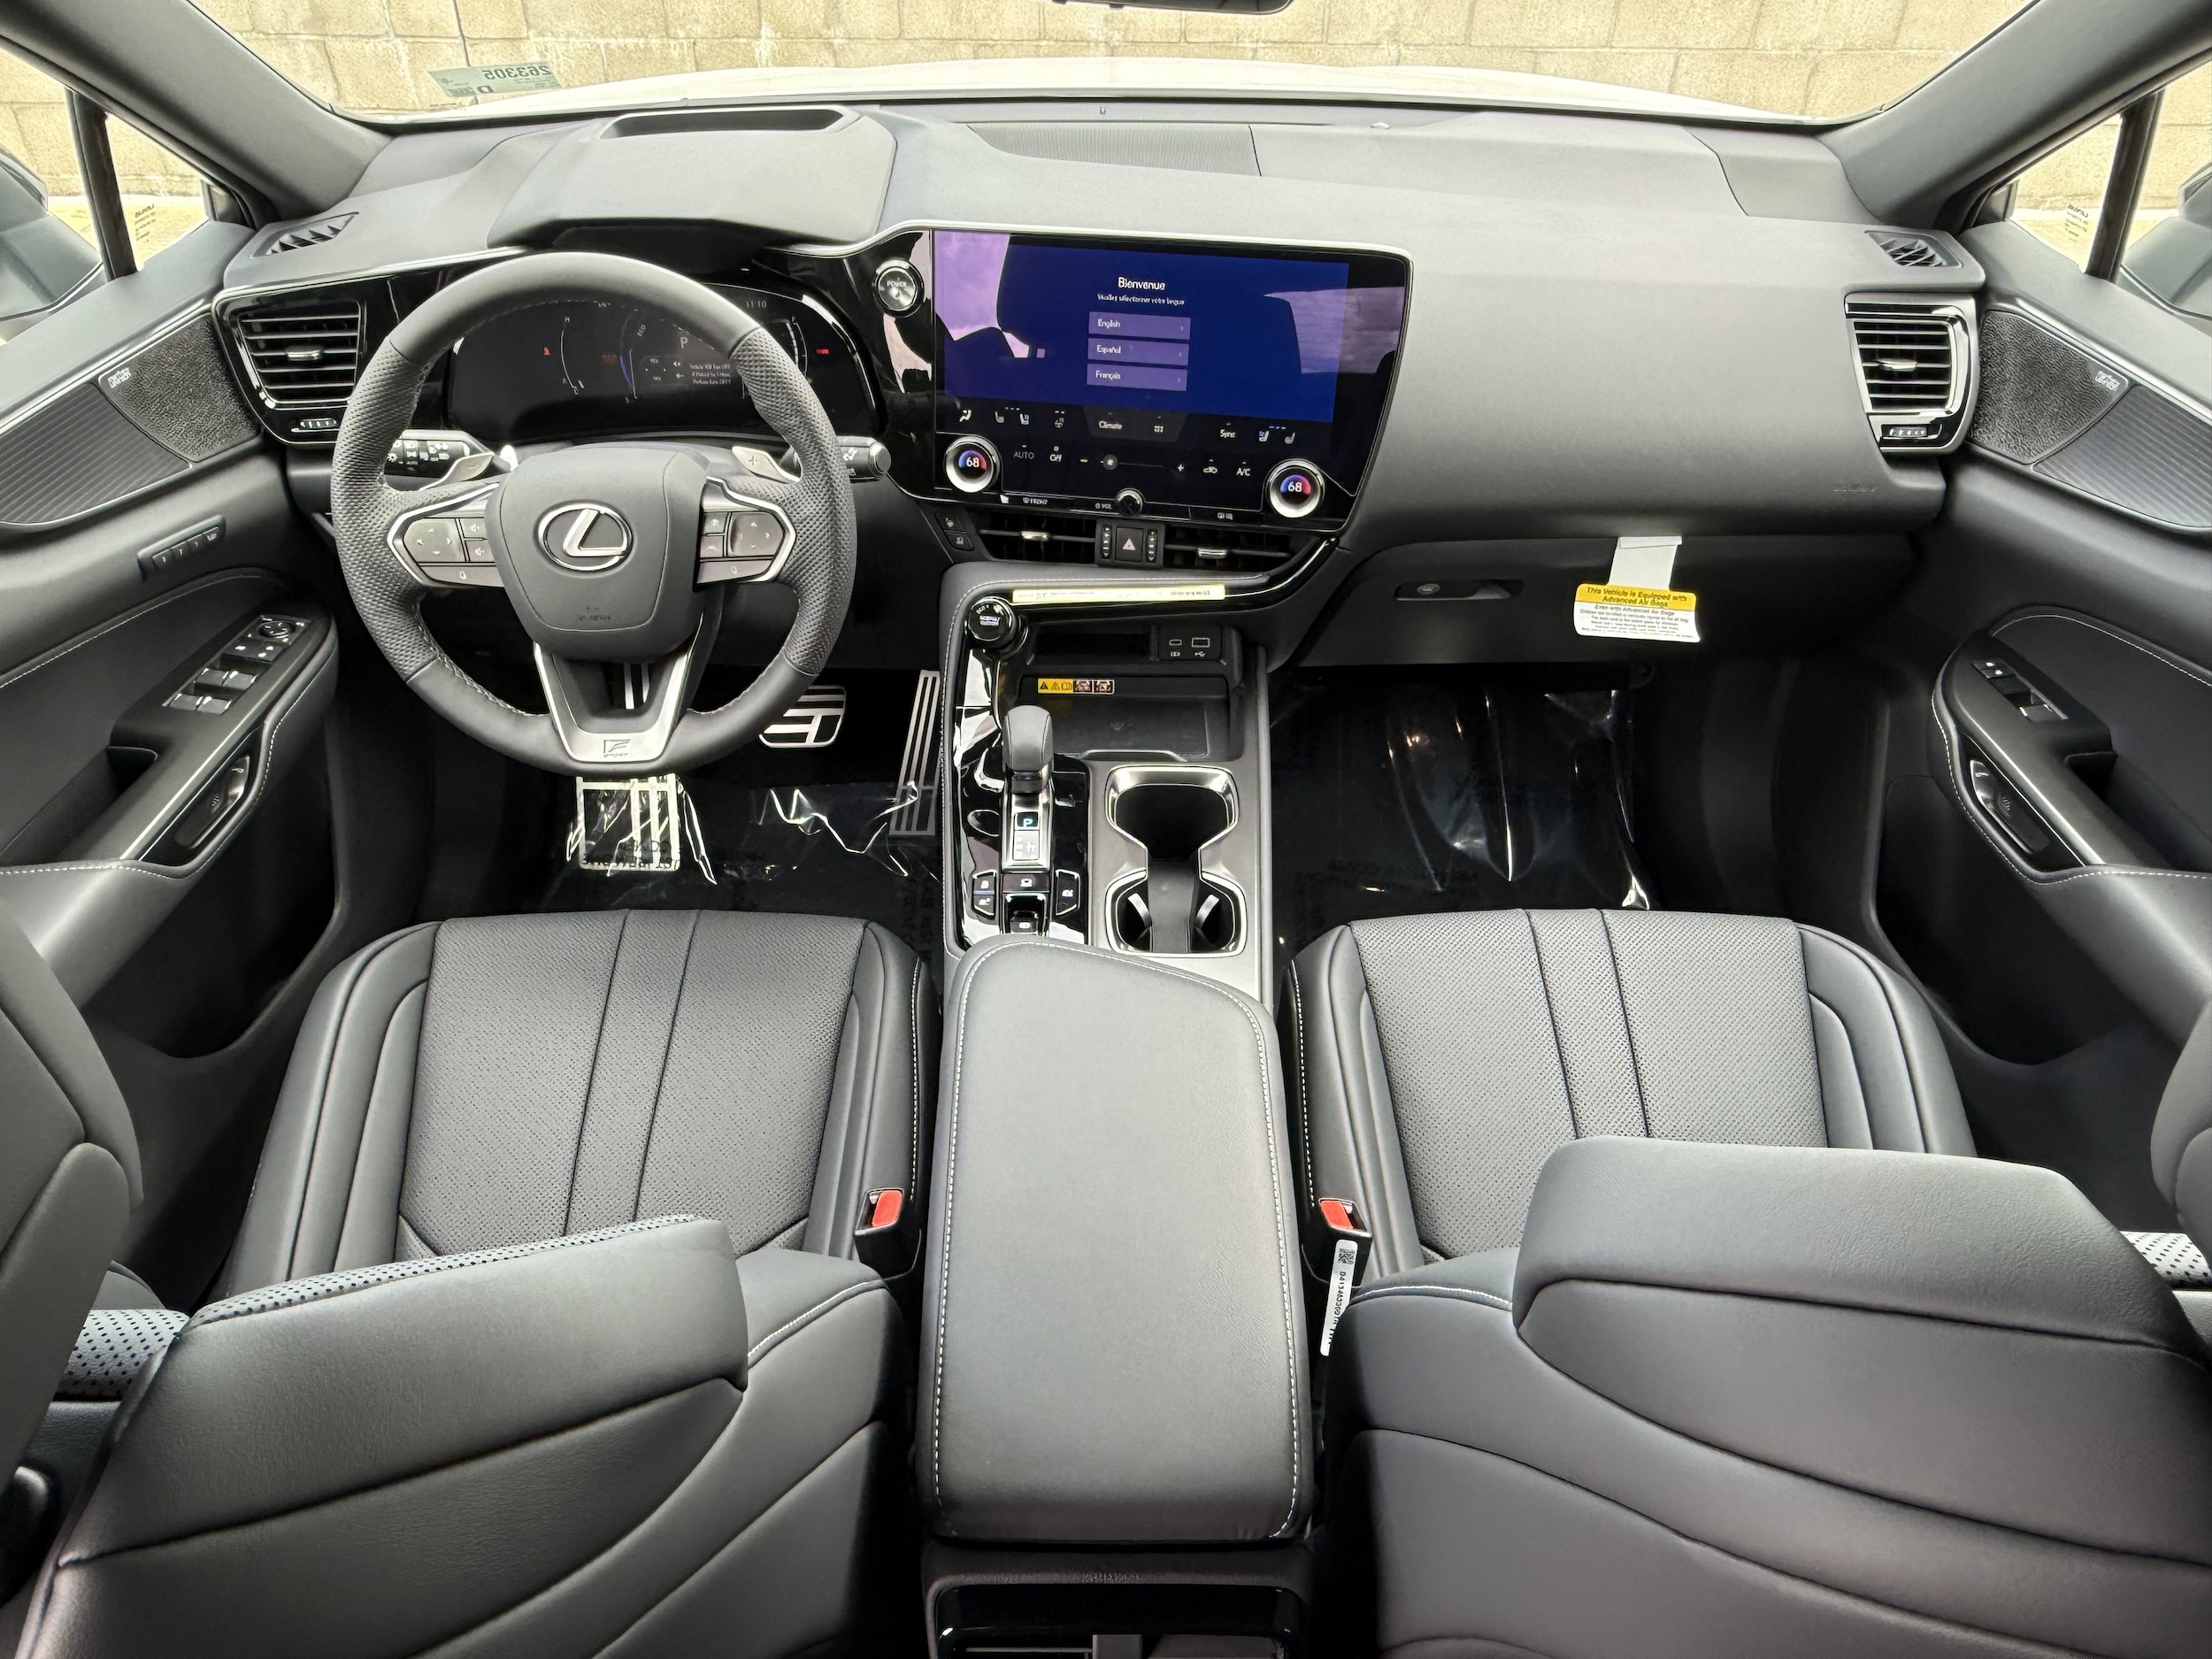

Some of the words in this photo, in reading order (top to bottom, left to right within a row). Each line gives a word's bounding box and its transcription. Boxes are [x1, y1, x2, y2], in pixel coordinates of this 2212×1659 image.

[1118, 276, 1165, 291] Bienvenue
[1097, 319, 1121, 329] English
[1096, 344, 1122, 354] Español
[1095, 370, 1121, 380] Français
[1098, 420, 1123, 430] Climate
[965, 457, 979, 468] 68
[1236, 467, 1251, 477] A/C
[1287, 481, 1302, 493] 68
[1023, 818, 1033, 827] P
